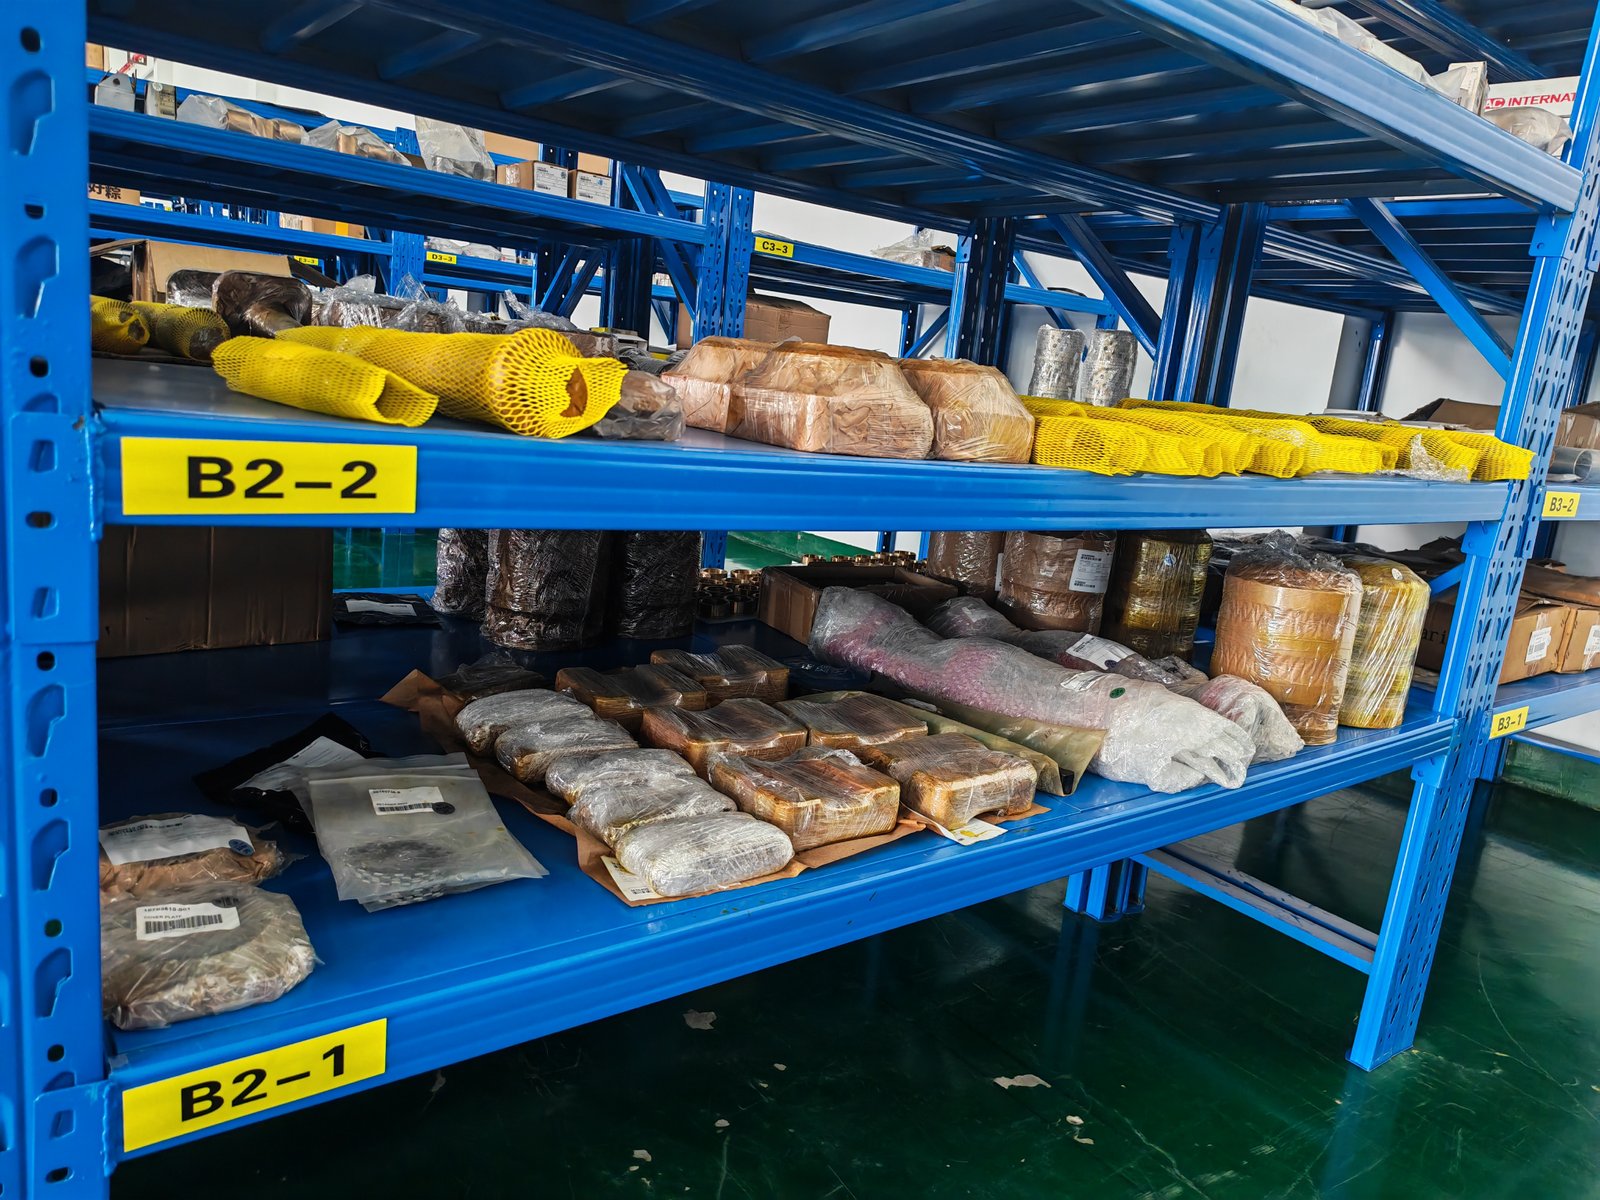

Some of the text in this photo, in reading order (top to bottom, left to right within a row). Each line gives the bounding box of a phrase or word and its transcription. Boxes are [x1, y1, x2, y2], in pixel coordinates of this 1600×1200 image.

[762, 240, 789, 254] C3-3
[432, 253, 453, 262] D3-3
[187, 456, 378, 499] B2-2
[1549, 496, 1575, 512] B3-2
[1497, 713, 1523, 731] B3-1
[180, 1043, 345, 1123] B2-1
